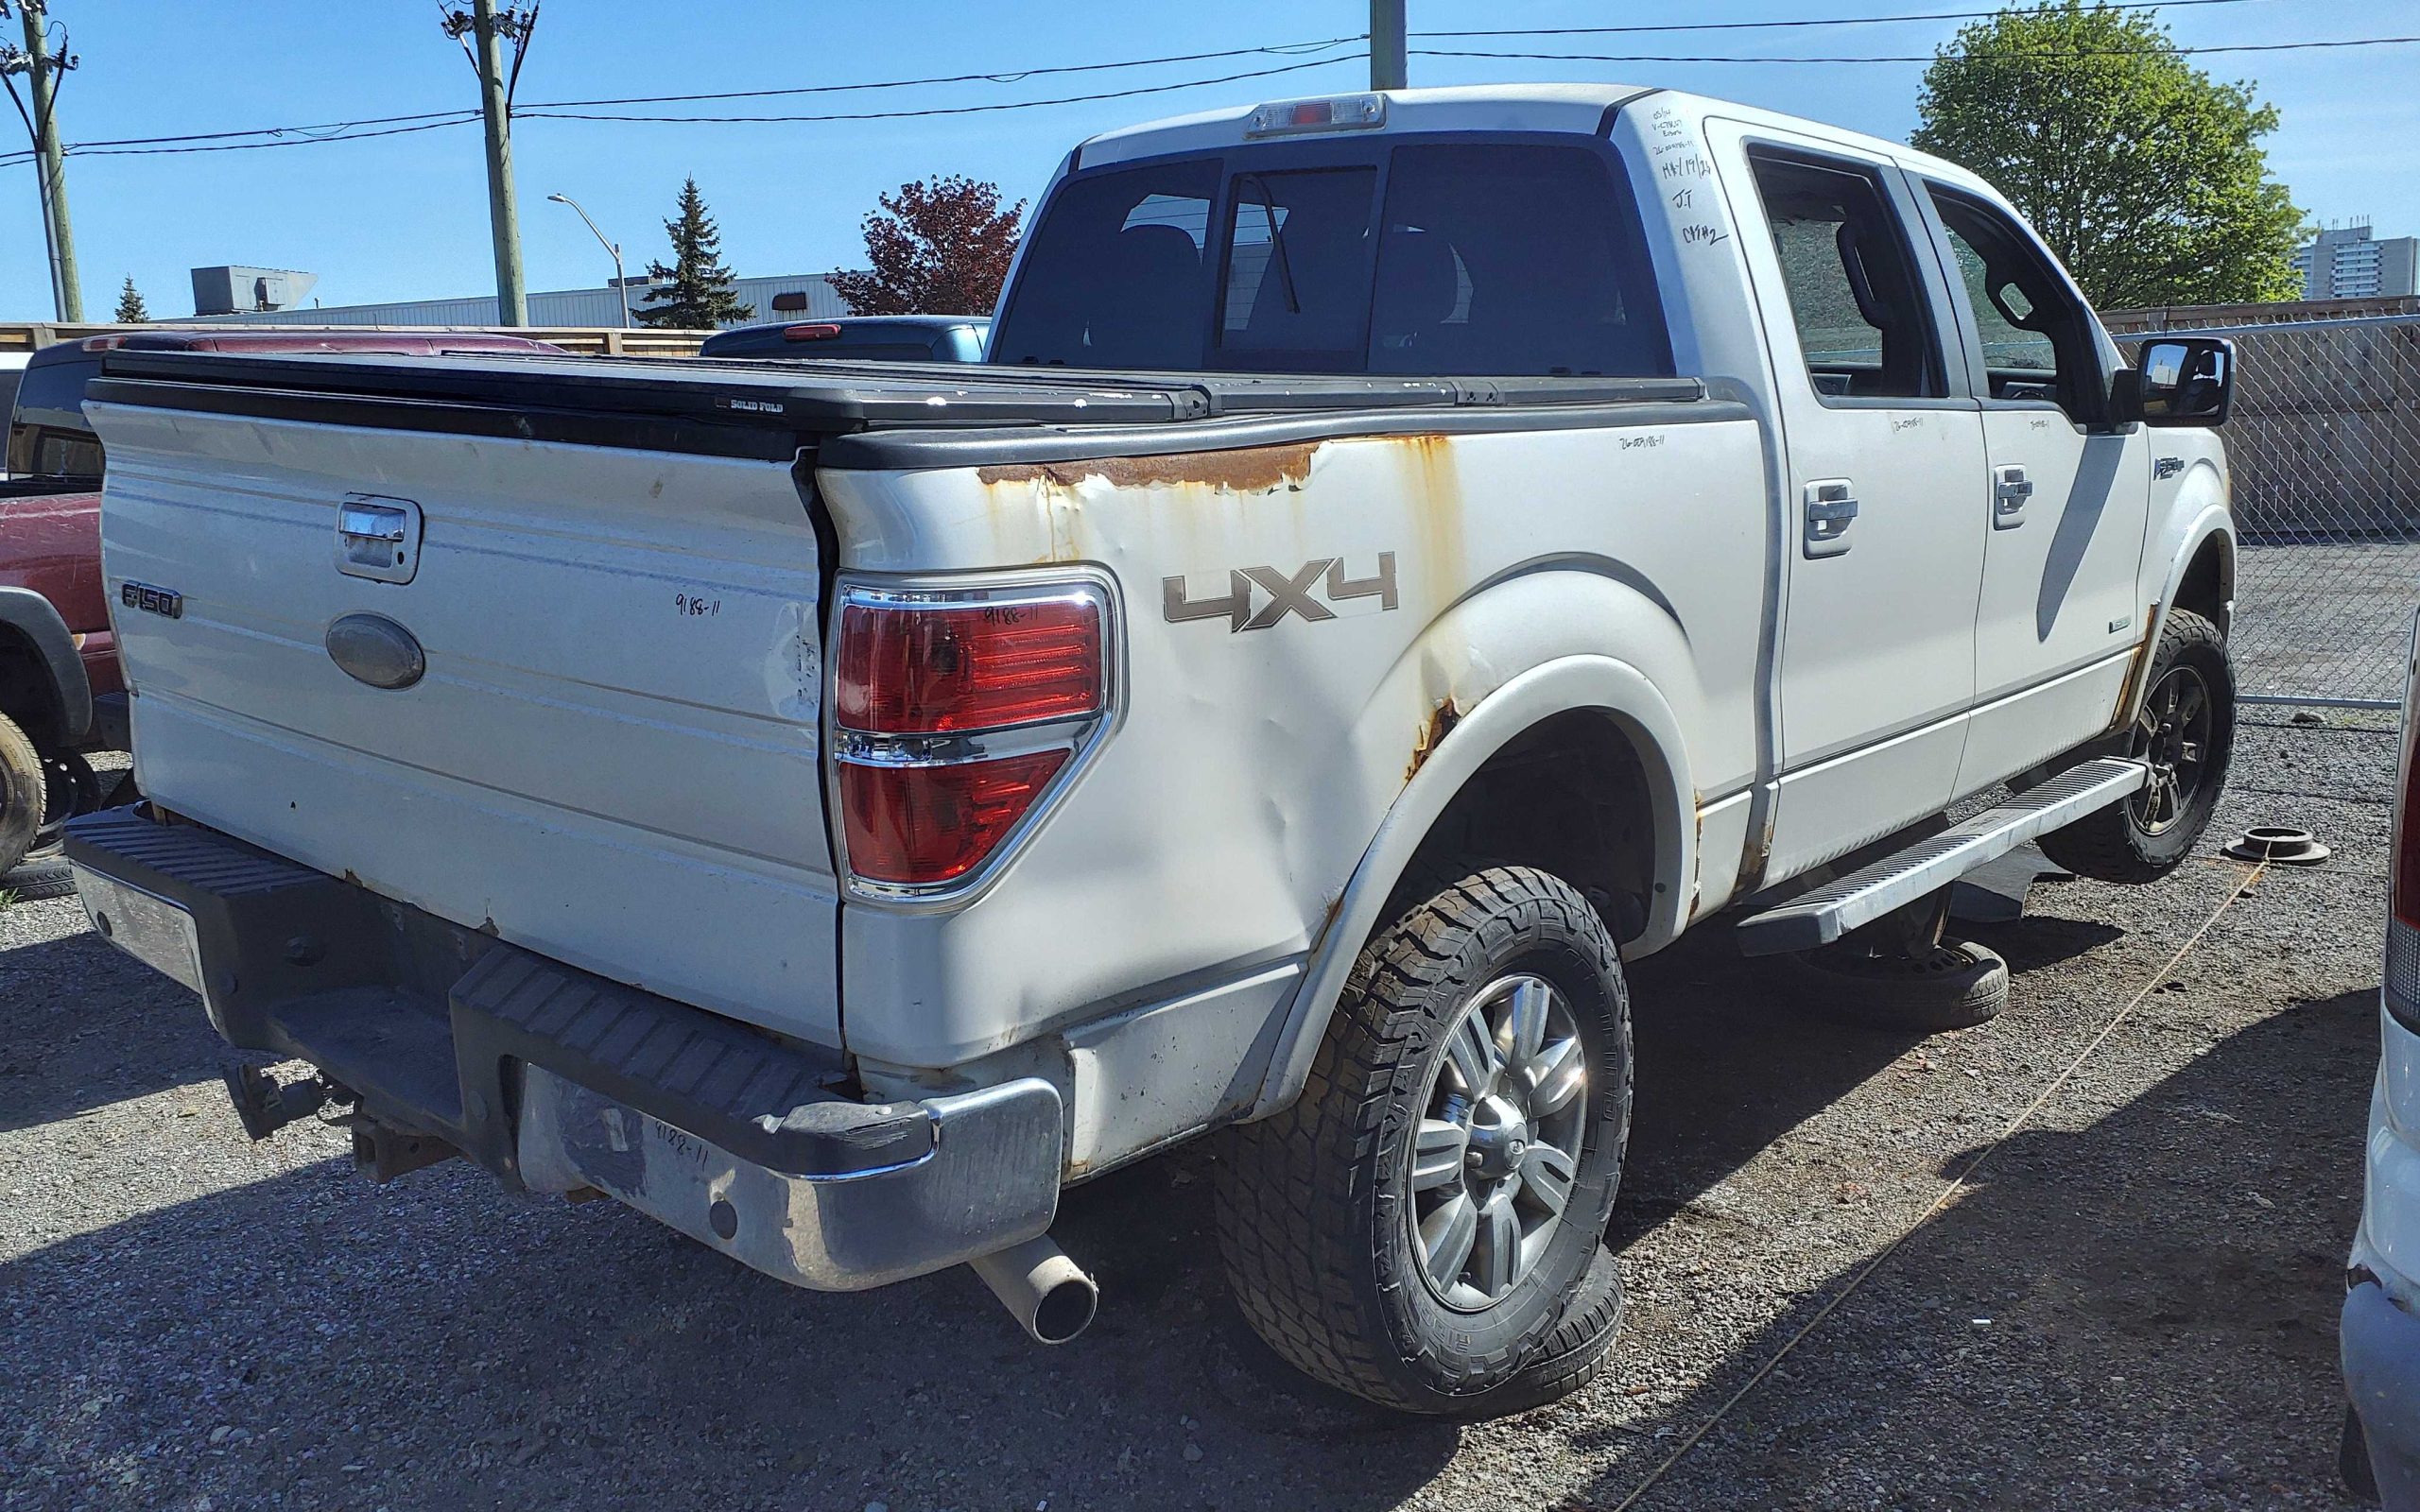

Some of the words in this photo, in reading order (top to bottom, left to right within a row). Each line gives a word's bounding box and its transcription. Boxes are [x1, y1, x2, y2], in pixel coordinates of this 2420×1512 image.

[730, 399, 758, 411] SOLID
[759, 402, 784, 413] FOLD
[675, 593, 721, 617] 9188-11
[984, 602, 1039, 627] 9188-11
[655, 1119, 710, 1173] 9188-11
